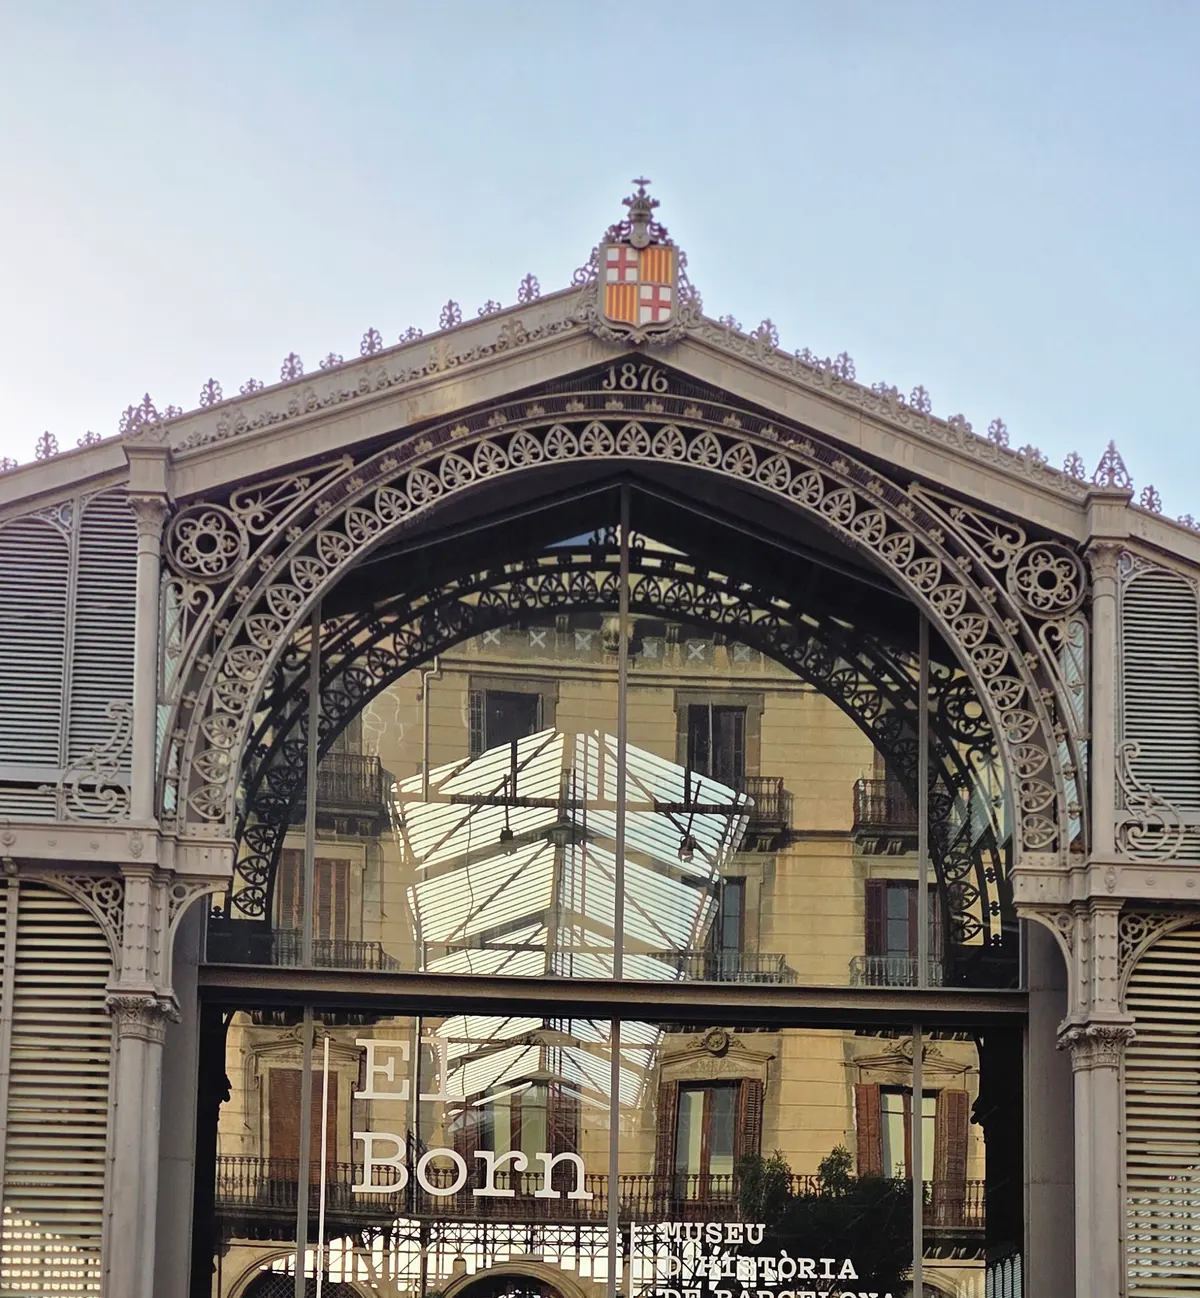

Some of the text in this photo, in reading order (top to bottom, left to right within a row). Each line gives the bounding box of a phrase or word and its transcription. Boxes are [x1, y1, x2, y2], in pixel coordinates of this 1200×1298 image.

[602, 363, 668, 392] 1876
[354, 1037, 466, 1102] El
[351, 1132, 594, 1199] Born
[662, 1221, 766, 1245] MUSEU
